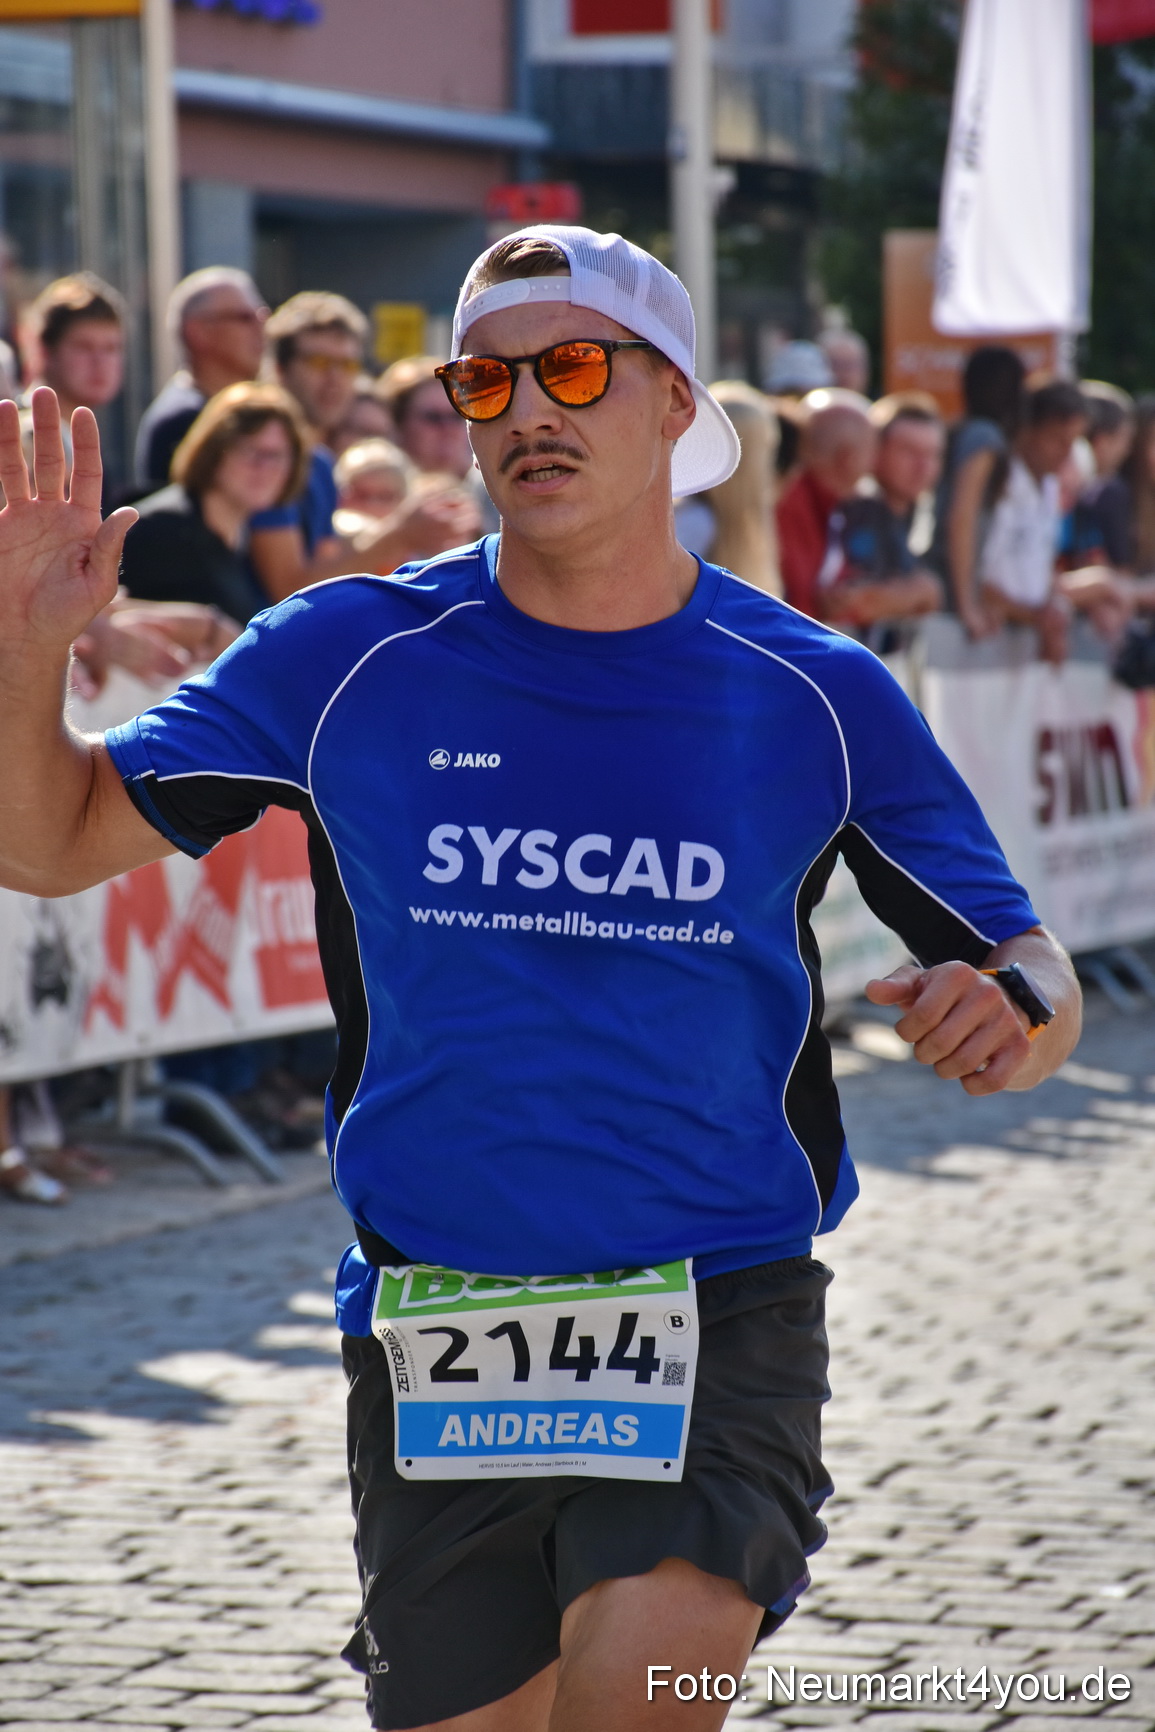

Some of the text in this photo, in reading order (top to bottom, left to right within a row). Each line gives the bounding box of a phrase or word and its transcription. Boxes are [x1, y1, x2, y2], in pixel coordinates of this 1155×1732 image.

[453, 752, 501, 768] JAKO
[422, 823, 726, 902] SYSCAD
[409, 906, 735, 945] www.metallbau-cad.de
[669, 1315, 684, 1328] B
[416, 1312, 661, 1384] 2144
[437, 1412, 640, 1447] ANDREAS
